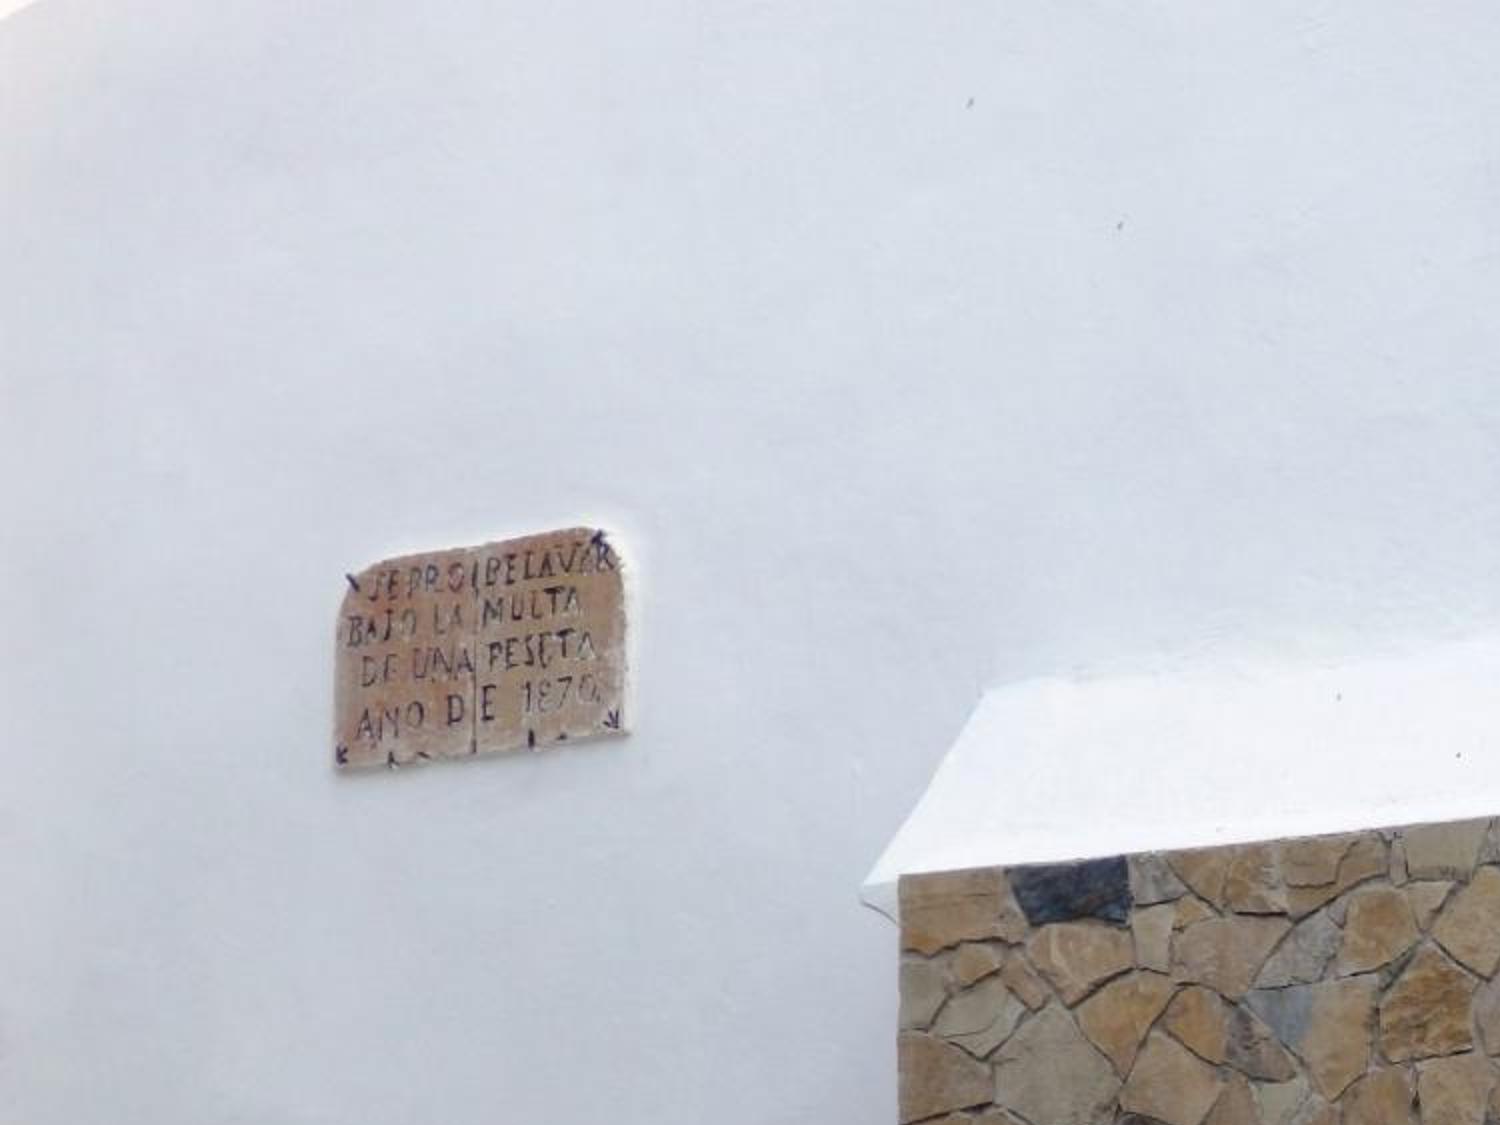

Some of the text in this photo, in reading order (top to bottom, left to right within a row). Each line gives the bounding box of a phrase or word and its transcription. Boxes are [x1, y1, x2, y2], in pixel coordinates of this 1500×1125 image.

[347, 585, 580, 648] BAJO LA MULTA
[361, 627, 598, 688] DE UNA PESETA
[446, 684, 498, 727] DE
